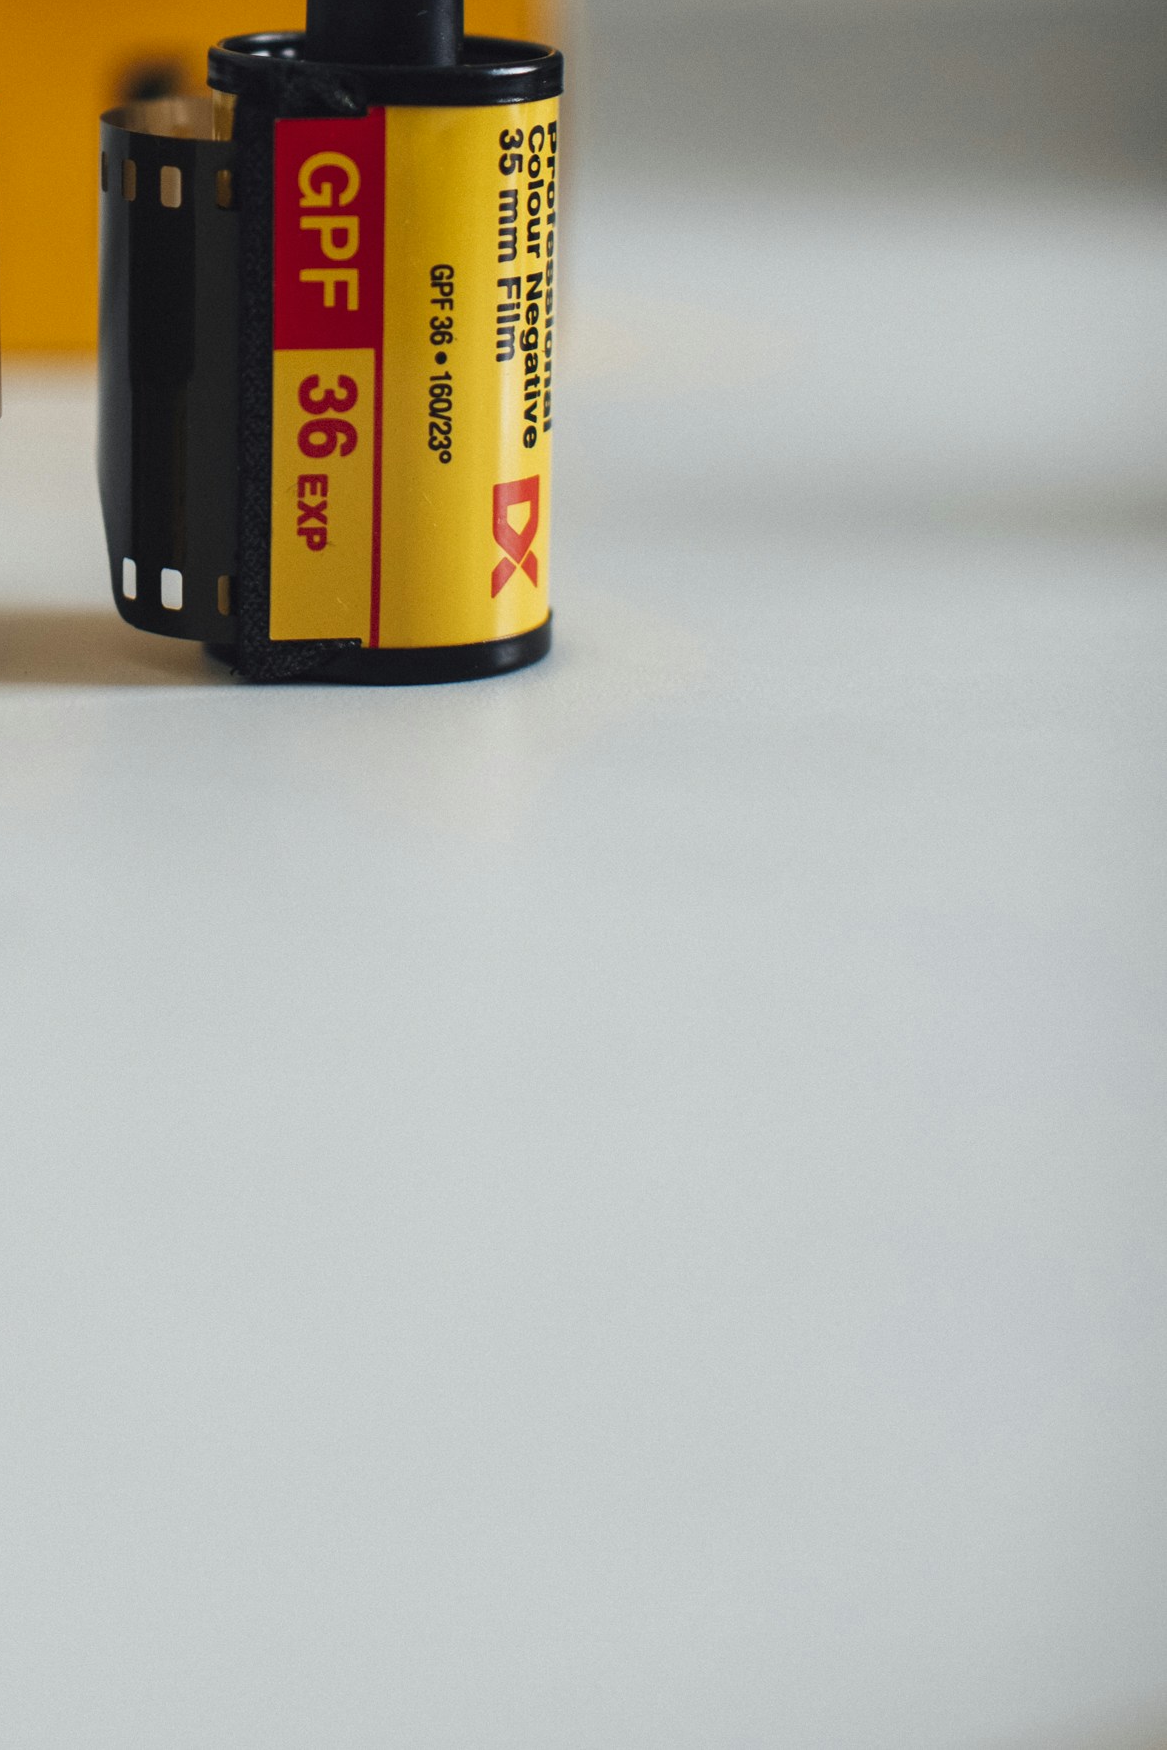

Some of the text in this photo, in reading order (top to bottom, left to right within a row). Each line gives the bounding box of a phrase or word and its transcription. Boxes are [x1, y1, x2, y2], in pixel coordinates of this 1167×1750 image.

[430, 264, 454, 311] GPF
[430, 317, 454, 345] 36
[496, 129, 523, 362] 35 mm Film
[521, 125, 545, 449] Colour Negative
[298, 151, 360, 551] GPF 36 EXP
[491, 475, 540, 599] DX
